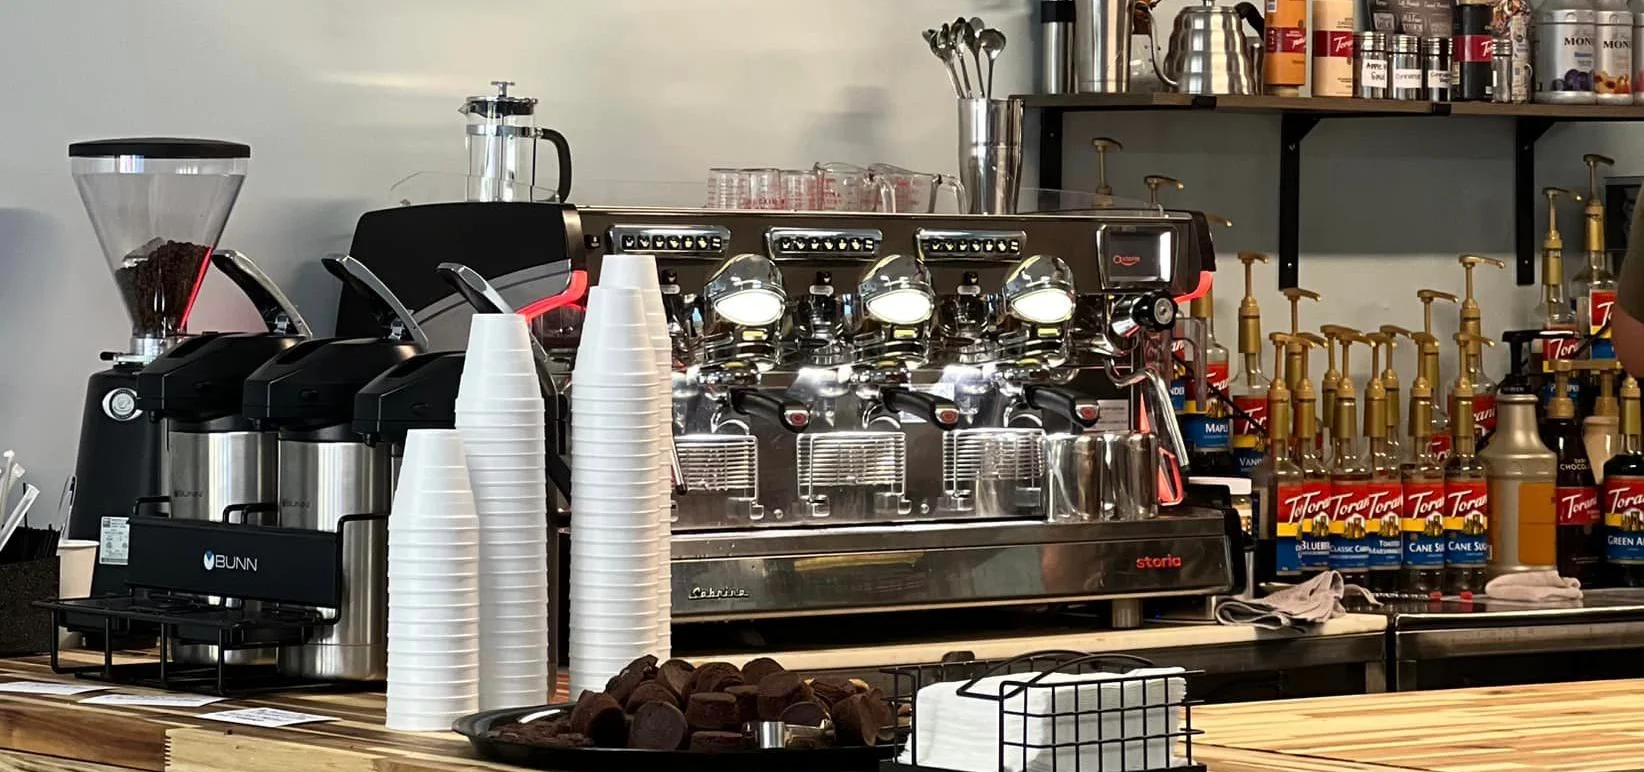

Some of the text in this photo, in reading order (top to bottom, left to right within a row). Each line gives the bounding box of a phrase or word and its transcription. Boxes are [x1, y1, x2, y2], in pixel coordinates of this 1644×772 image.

[1448, 541, 1472, 551] CANE
[1608, 535, 1634, 546] GREEN
[1409, 543, 1433, 553] CANE
[215, 554, 257, 571] BUNN
[1136, 553, 1182, 569] storia
